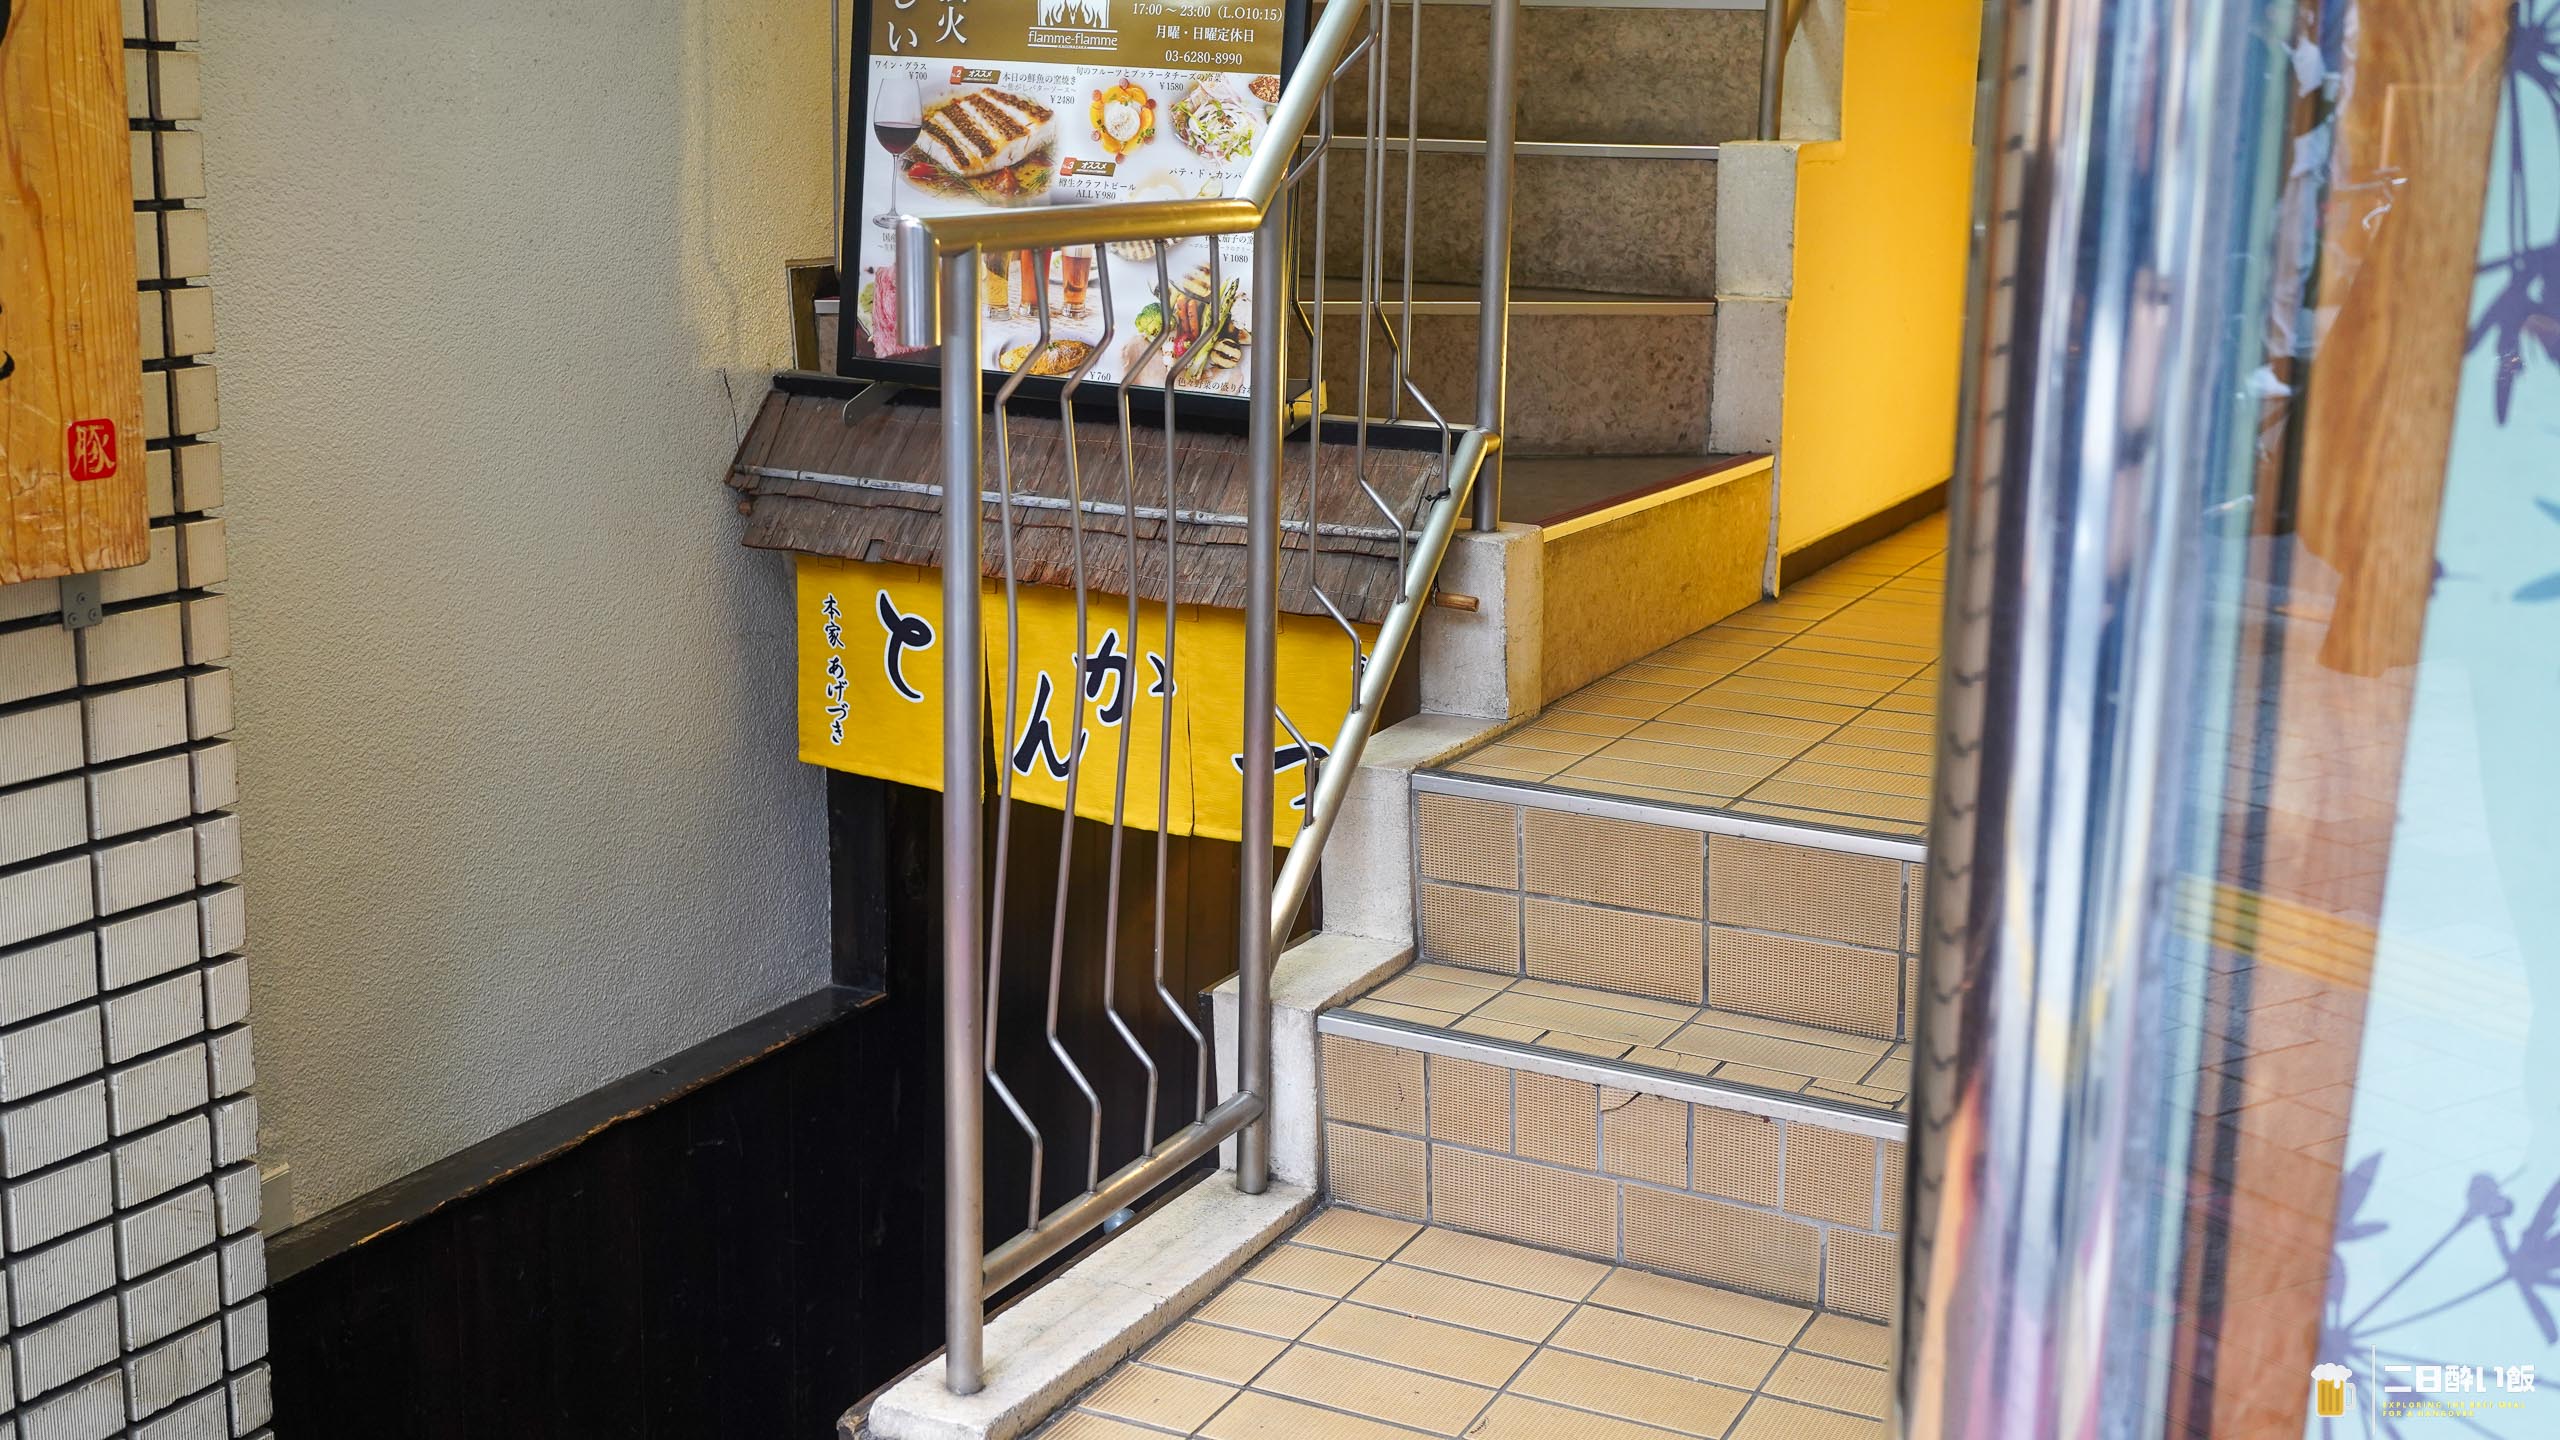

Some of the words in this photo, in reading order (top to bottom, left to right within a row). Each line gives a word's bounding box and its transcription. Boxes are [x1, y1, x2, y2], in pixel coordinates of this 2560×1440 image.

[1132, 3, 1162, 16] 17:00
[1179, 6, 1211, 18] 23:00
[1028, 30, 1118, 46] flamme-flamme
[1156, 25, 1254, 43] 月曜・日曜定休日
[1165, 49, 1243, 65] 03-6280-8990
[968, 69, 993, 79] オススメ
[1081, 160, 1108, 171] オススメ
[1223, 253, 1249, 263] ¥1080
[1089, 371, 1112, 382] ¥760
[822, 593, 845, 649] 本家
[826, 655, 849, 745] あげづき
